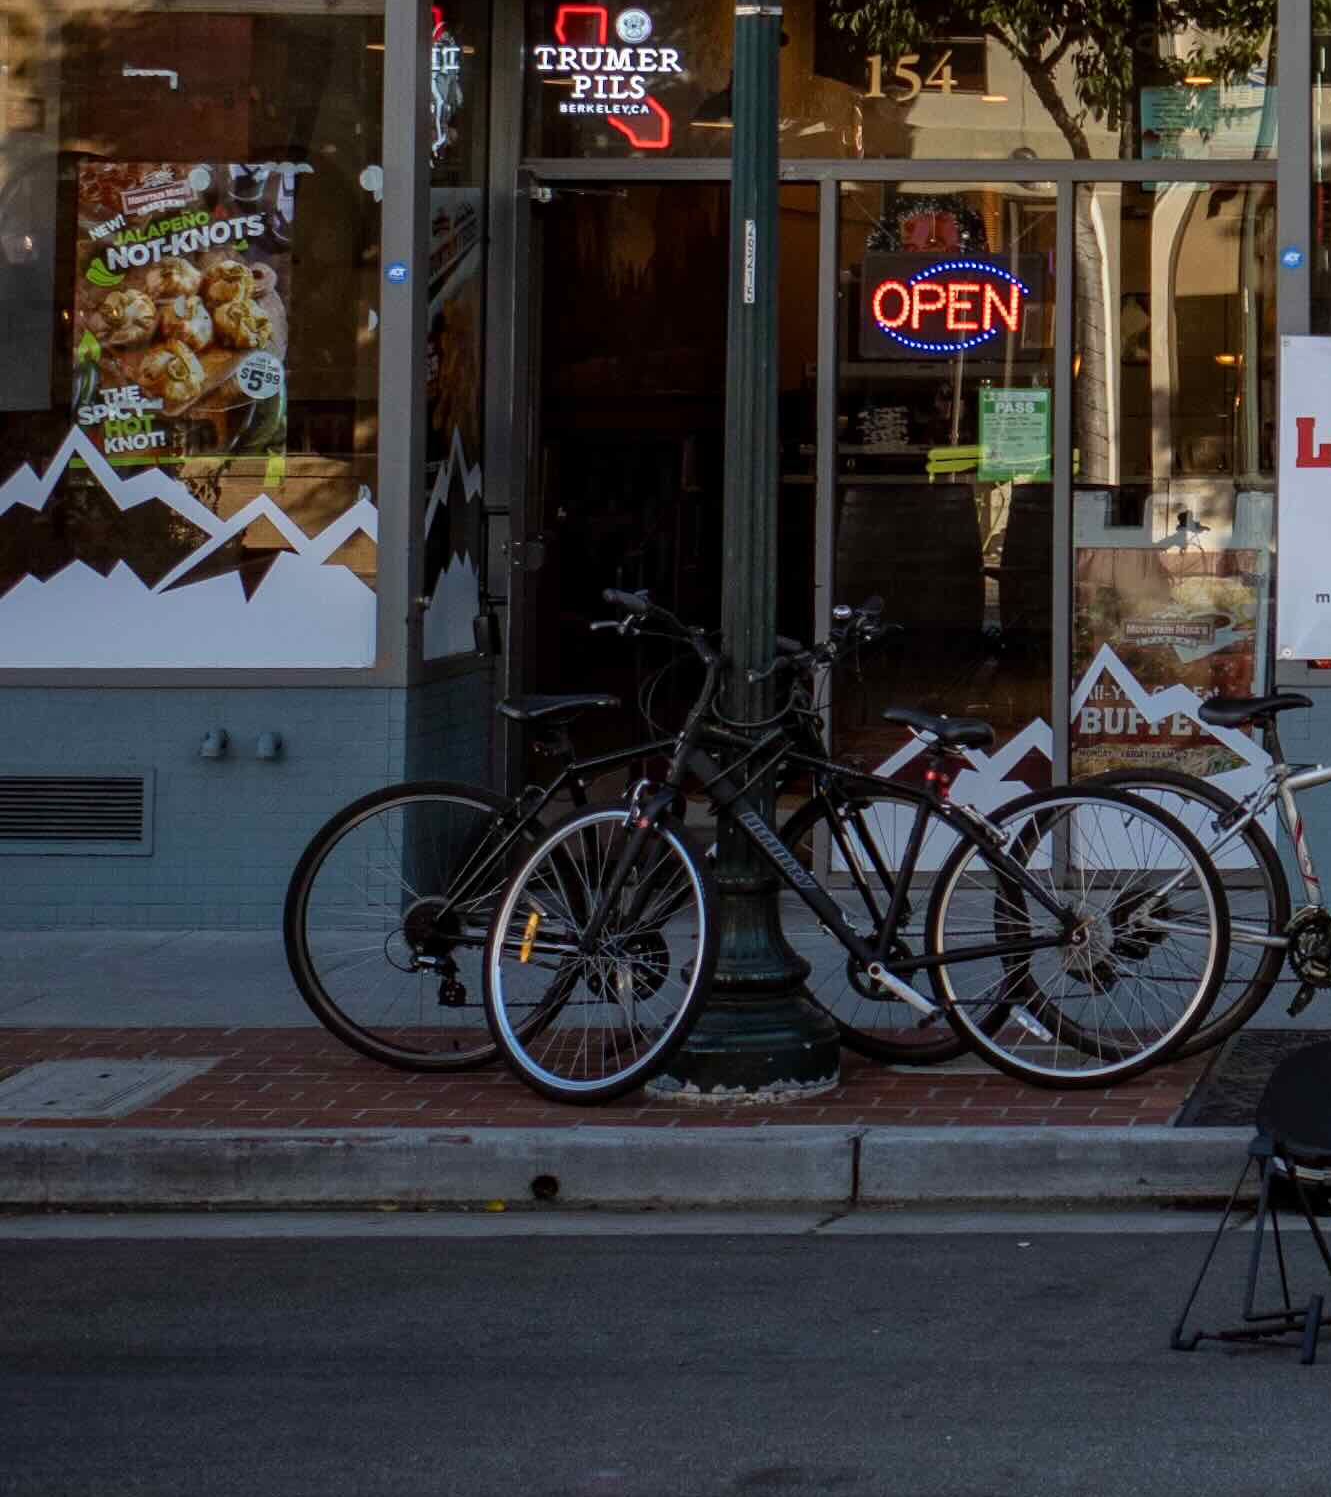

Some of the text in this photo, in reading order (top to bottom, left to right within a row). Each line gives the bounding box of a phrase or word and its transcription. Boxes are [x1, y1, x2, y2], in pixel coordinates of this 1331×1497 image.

[533, 45, 684, 73] TRUMER
[571, 75, 647, 100] PILS
[864, 49, 959, 103] 154
[88, 213, 128, 242] NEW!
[113, 211, 211, 247] JALAPEÑO
[106, 214, 266, 272] NOT-KNOTS
[872, 279, 1021, 333] OPEN
[99, 384, 142, 406] THE
[994, 402, 1036, 414] PASS
[104, 412, 155, 437] HOT
[104, 430, 167, 454] KNOT!
